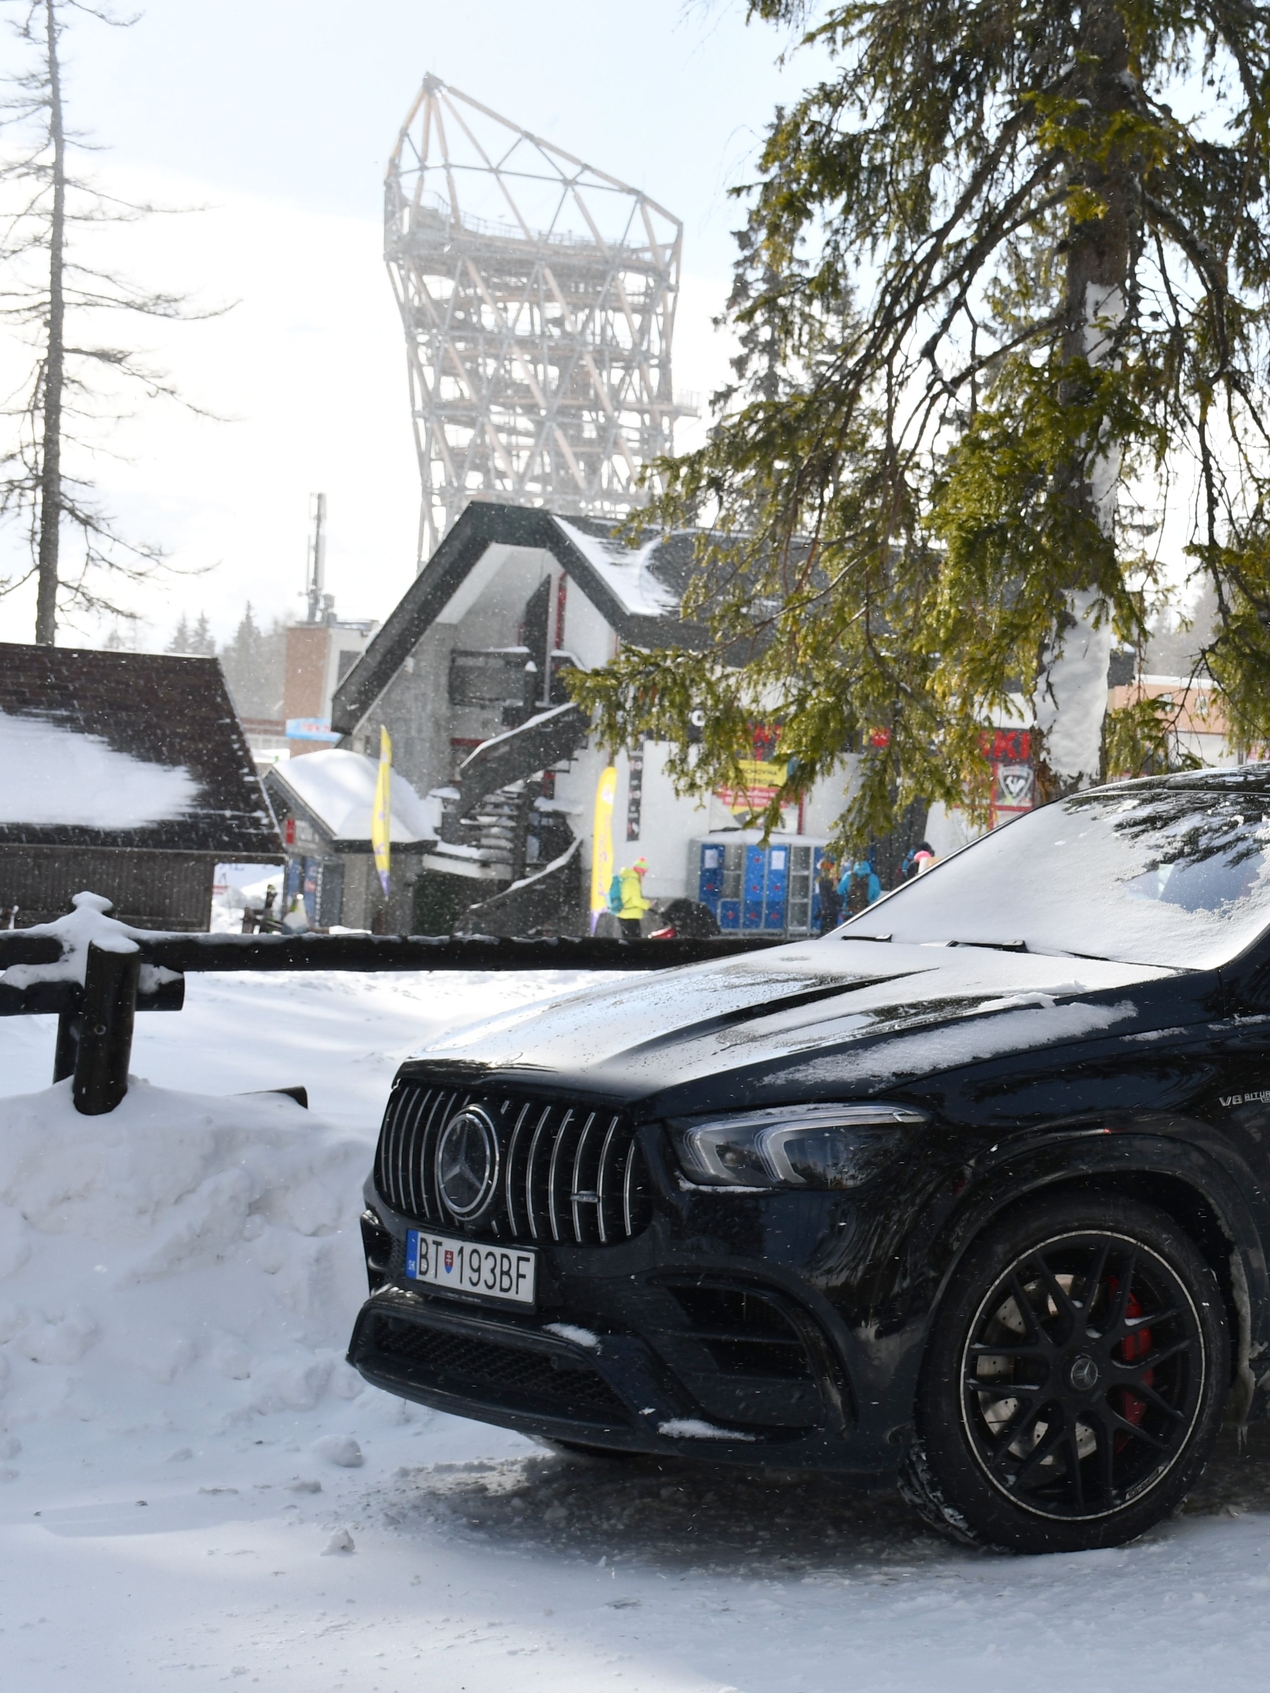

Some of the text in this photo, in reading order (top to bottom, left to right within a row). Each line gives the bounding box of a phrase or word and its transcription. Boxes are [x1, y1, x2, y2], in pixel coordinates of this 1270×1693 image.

[1219, 1095, 1243, 1107] V8
[418, 1236, 531, 1295] BT 193BF
